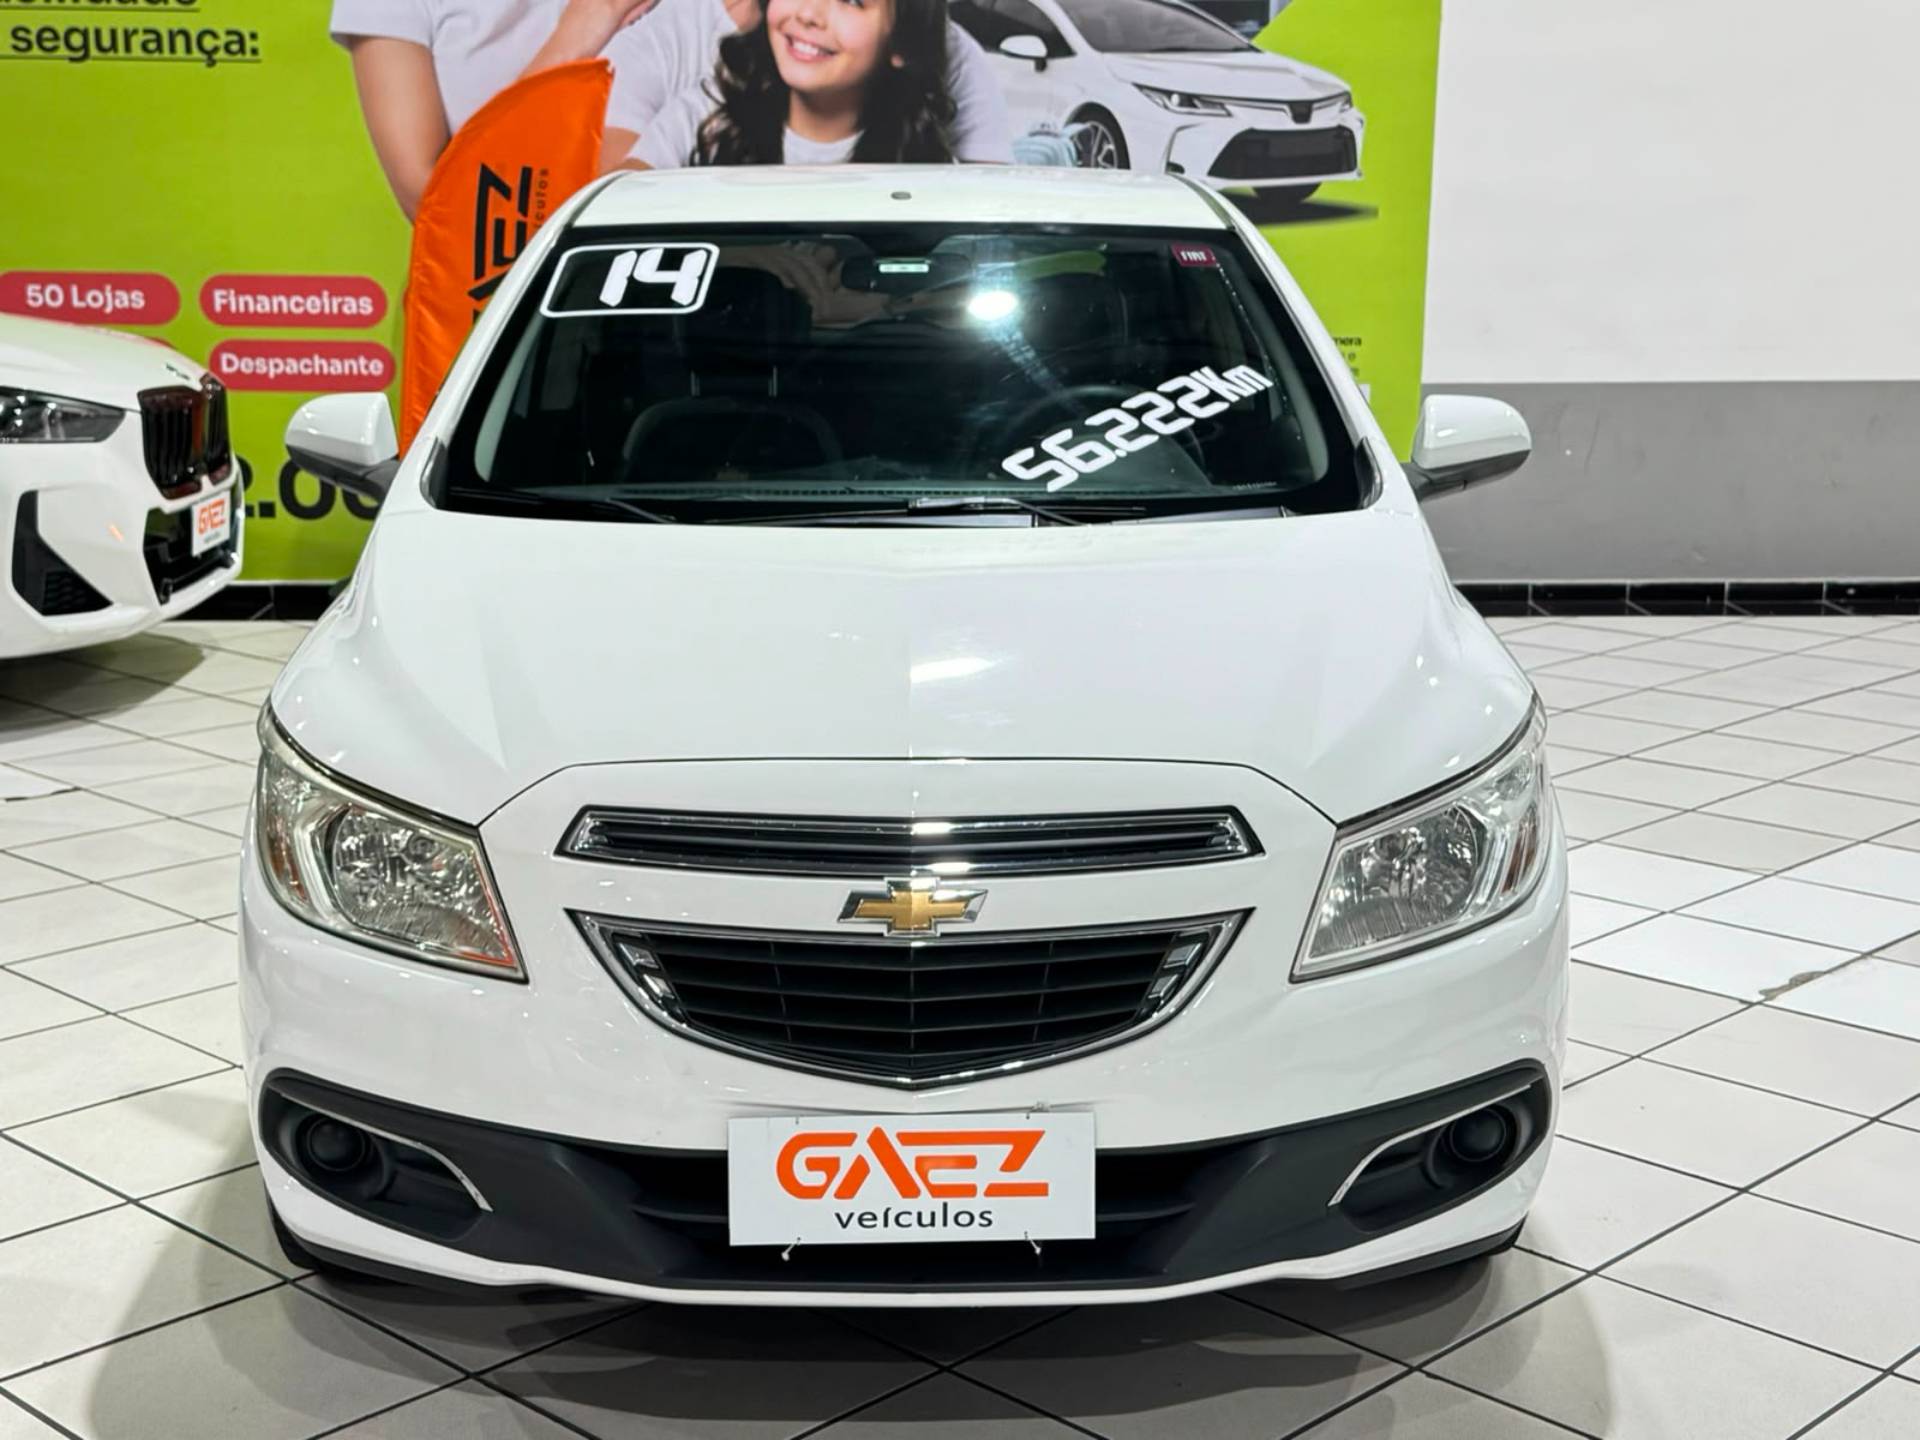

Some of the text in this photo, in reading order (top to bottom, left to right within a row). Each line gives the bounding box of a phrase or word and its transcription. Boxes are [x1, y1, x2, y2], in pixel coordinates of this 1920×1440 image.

[10, 24, 260, 68] segurança:
[599, 247, 708, 307] 14
[26, 284, 146, 314] 50 Lojas
[213, 288, 374, 316] Financeiras
[220, 352, 384, 378] Despachante
[1002, 364, 1274, 492] 56.222Km
[776, 1126, 1049, 1200] GAEZ
[834, 1202, 993, 1229] veículos
